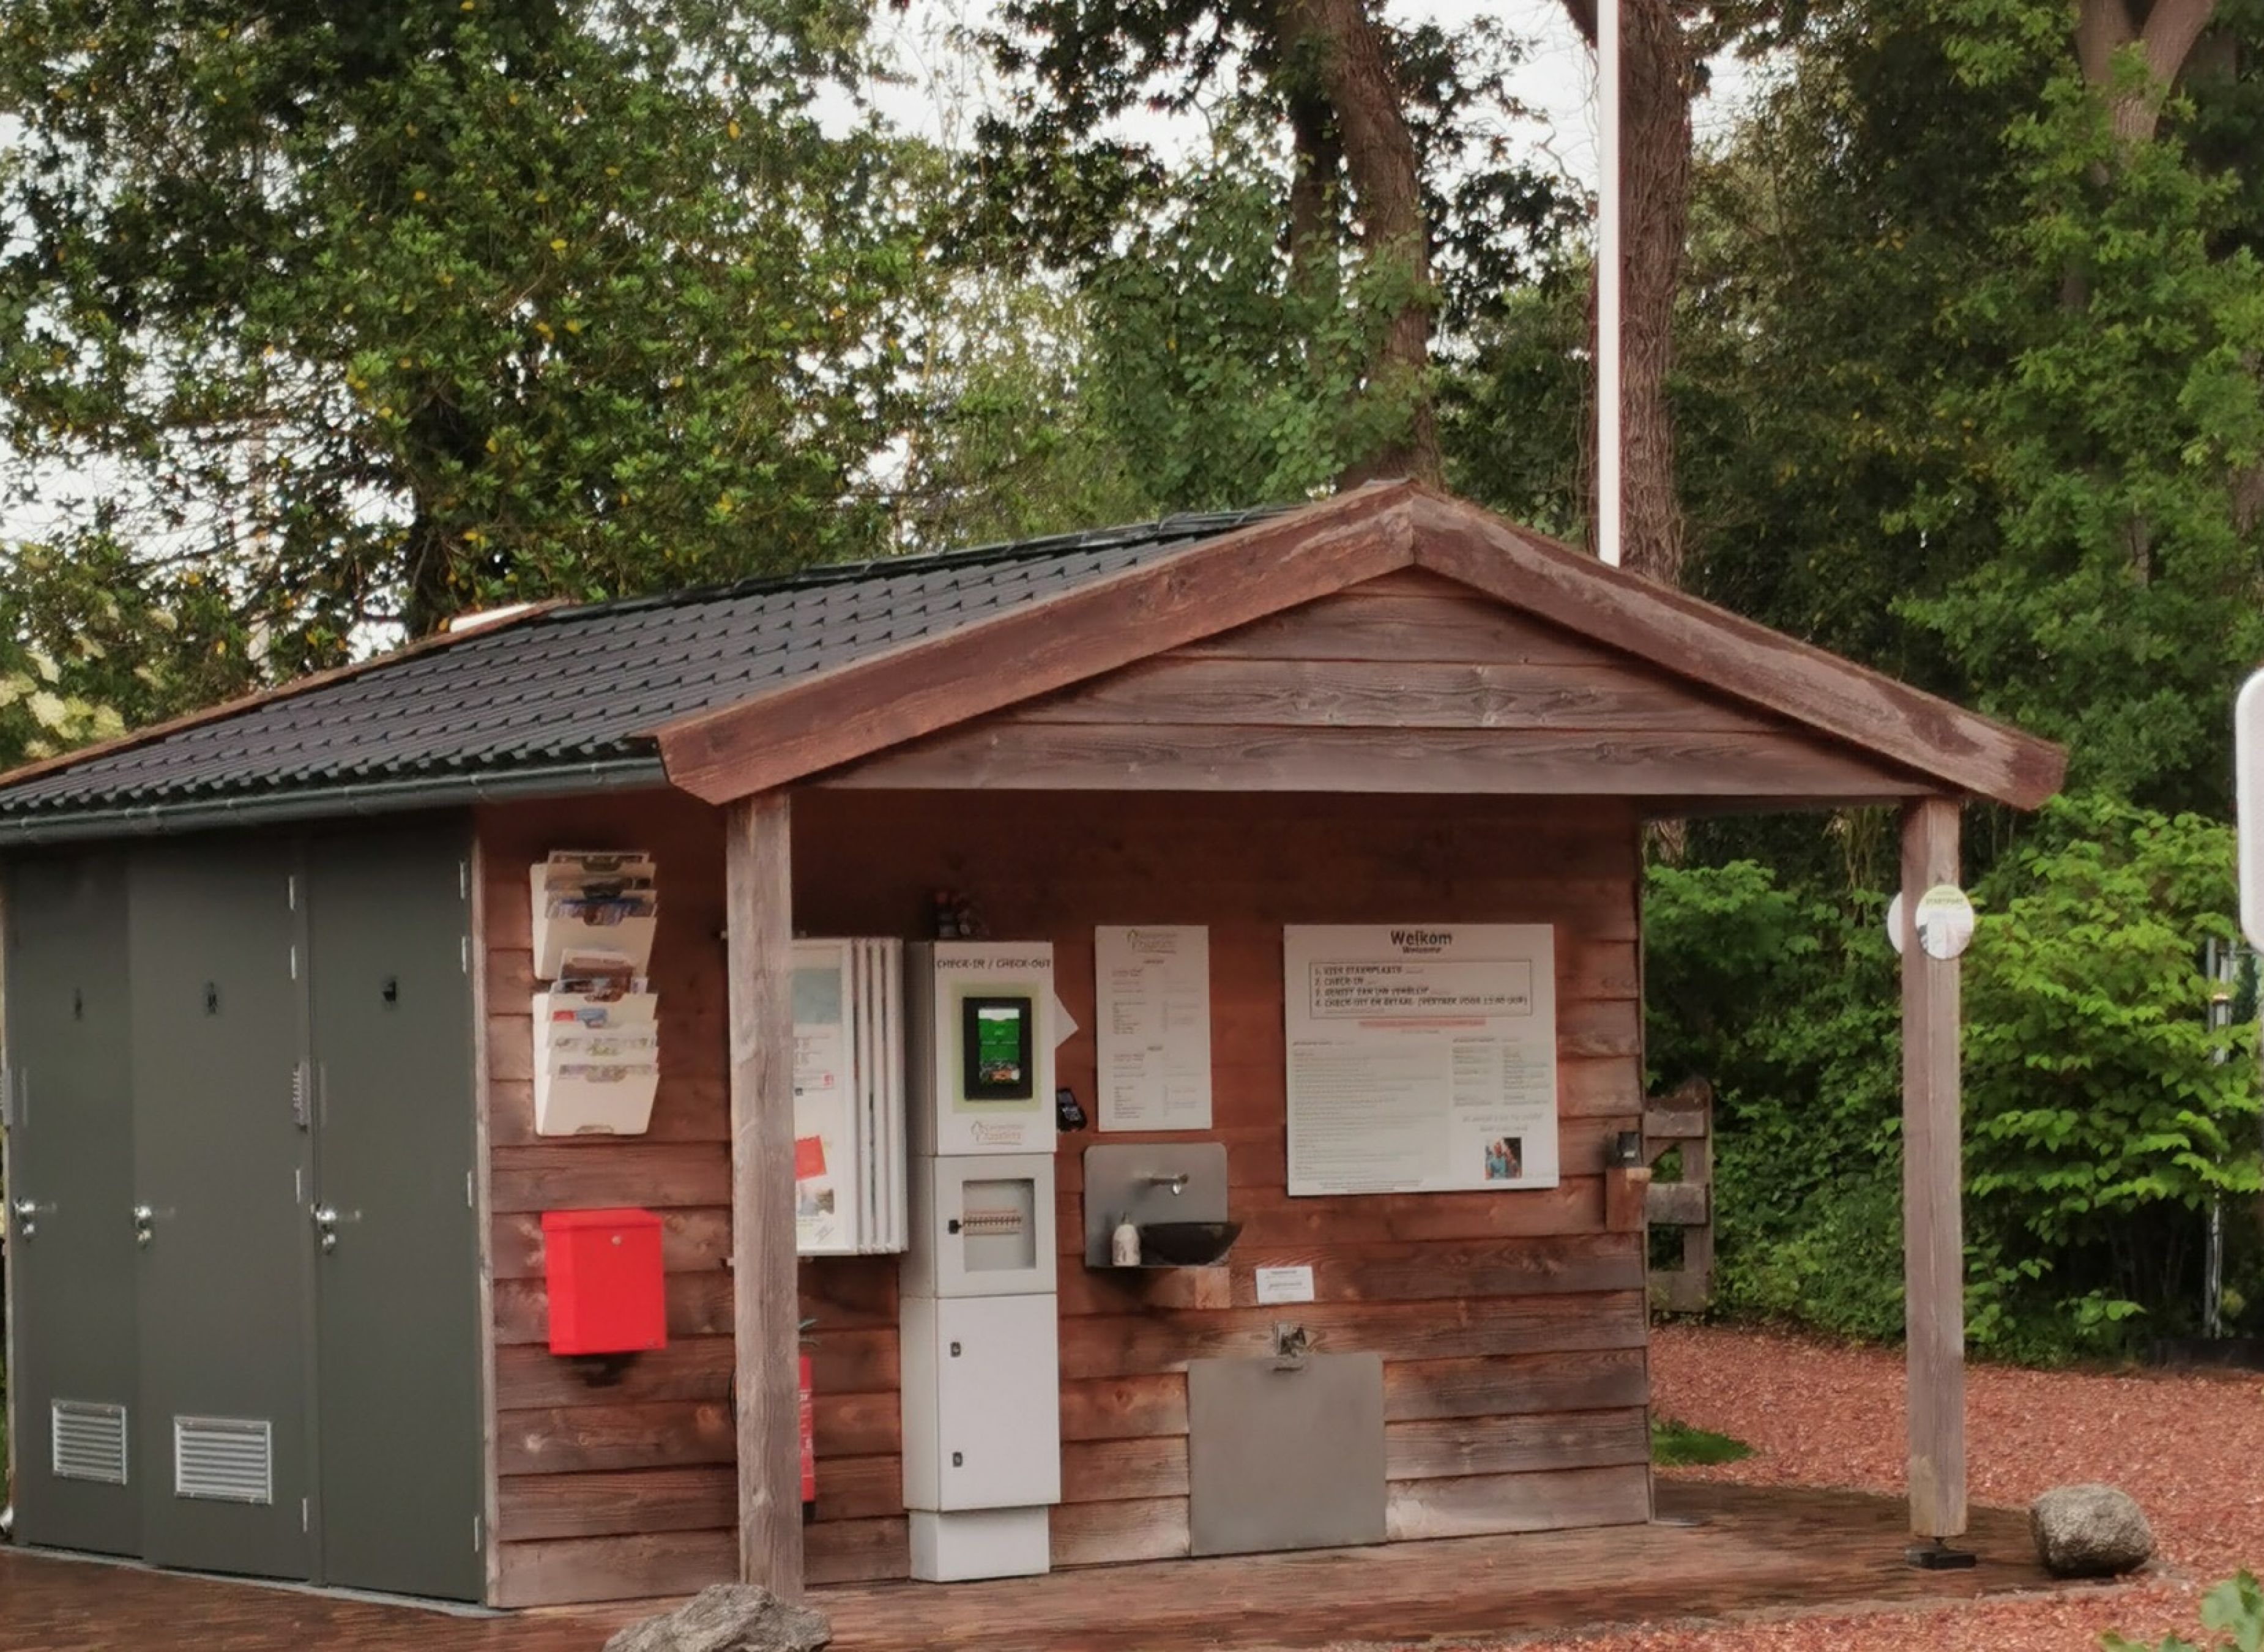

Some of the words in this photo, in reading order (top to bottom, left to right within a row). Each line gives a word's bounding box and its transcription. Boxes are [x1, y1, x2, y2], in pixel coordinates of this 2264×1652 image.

[1391, 929, 1453, 945] Welkom
[937, 959, 985, 970] CHECK-IN
[996, 958, 1051, 969] CHECK-OUT
